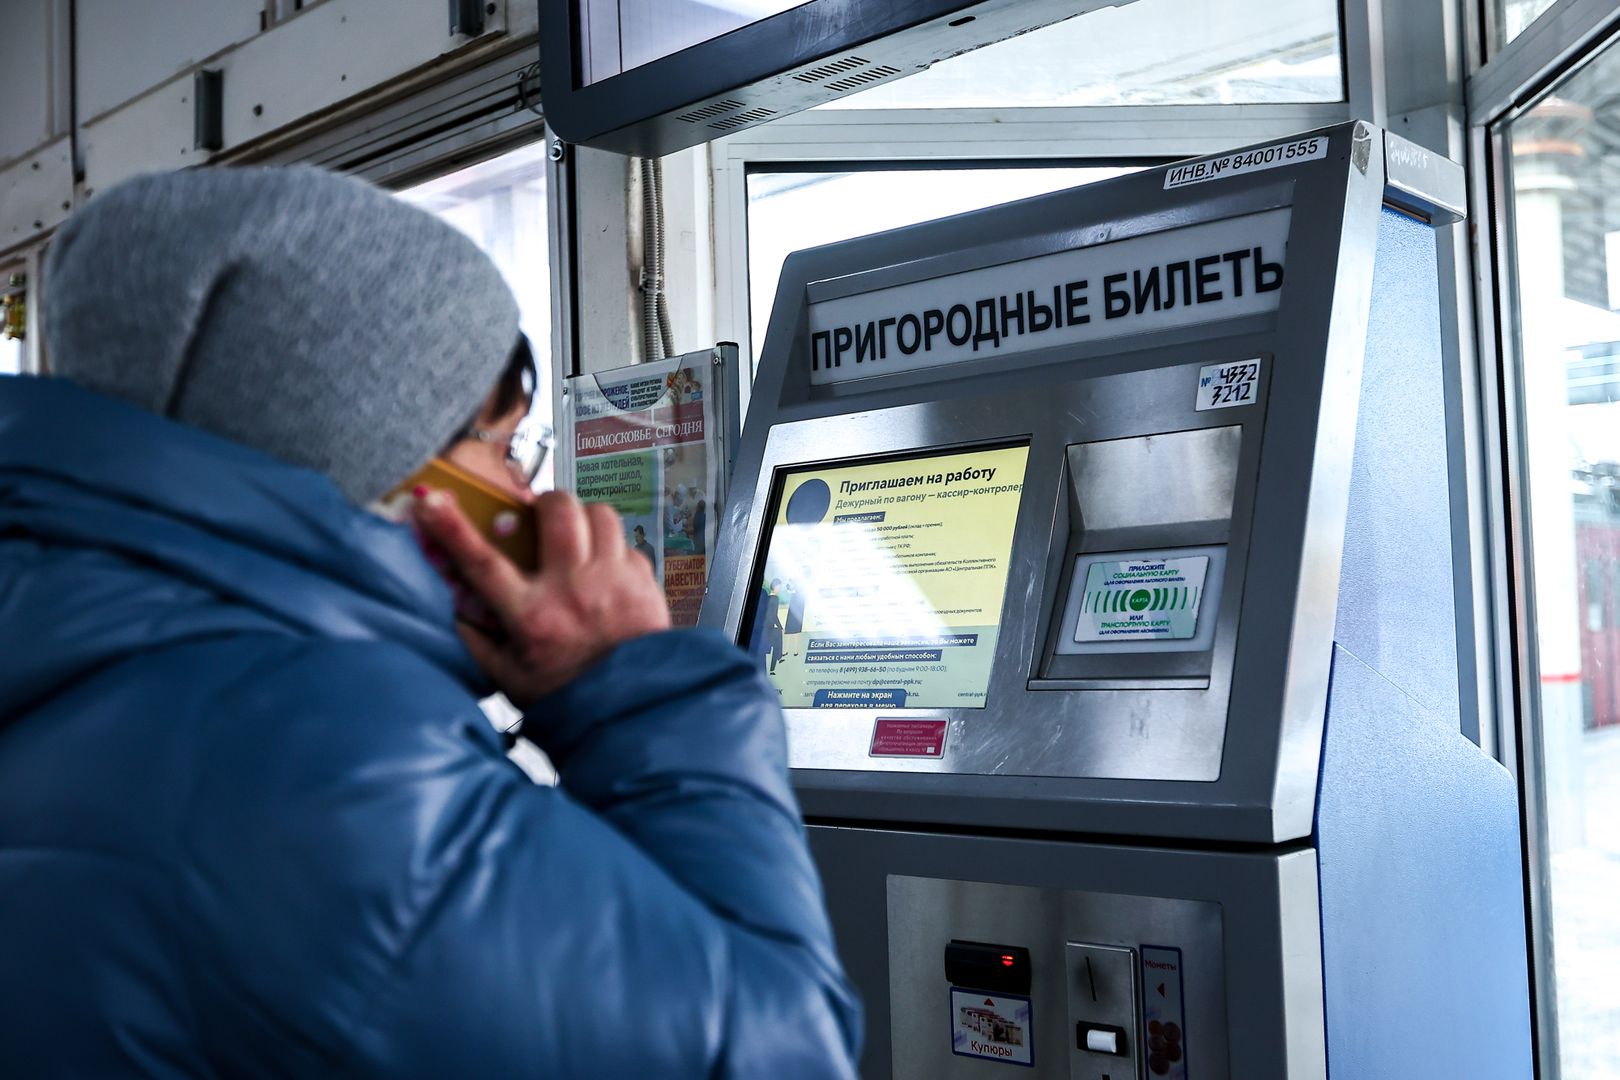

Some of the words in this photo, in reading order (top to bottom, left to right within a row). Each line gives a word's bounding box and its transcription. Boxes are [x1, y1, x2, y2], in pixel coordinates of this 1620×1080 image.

[1232, 139, 1319, 170] 84001555
[811, 281, 1090, 371] ПРИГОРОДНЫЕ
[1220, 363, 1258, 384] 4332
[656, 420, 703, 439] СЕГОДНЯ
[576, 461, 600, 473] Новая
[601, 456, 644, 471] котельная,
[576, 472, 618, 487] капремонт
[619, 470, 642, 481] школ,
[839, 474, 923, 495] Приглашаем
[926, 472, 944, 484] на
[945, 467, 997, 486] работу
[577, 482, 641, 498] благоустройство
[835, 496, 883, 510] Дежурный
[883, 495, 895, 504] по
[896, 493, 927, 504] вагону
[892, 524, 908, 532] рублей
[1113, 571, 1159, 579] СОЦИАЛЬНУЮ
[1128, 564, 1166, 572] ПРИЛОЖИТЕ
[1101, 620, 1149, 629] ТРАНСПОРТНУЮ
[810, 641, 825, 649] Если
[949, 637, 975, 645] можете
[807, 654, 835, 662] связаться
[827, 691, 861, 700] Нажмите
[861, 691, 871, 699] на
[871, 691, 893, 701] экран
[1144, 959, 1177, 971] Монеты
[970, 1040, 1013, 1057] Купюры
